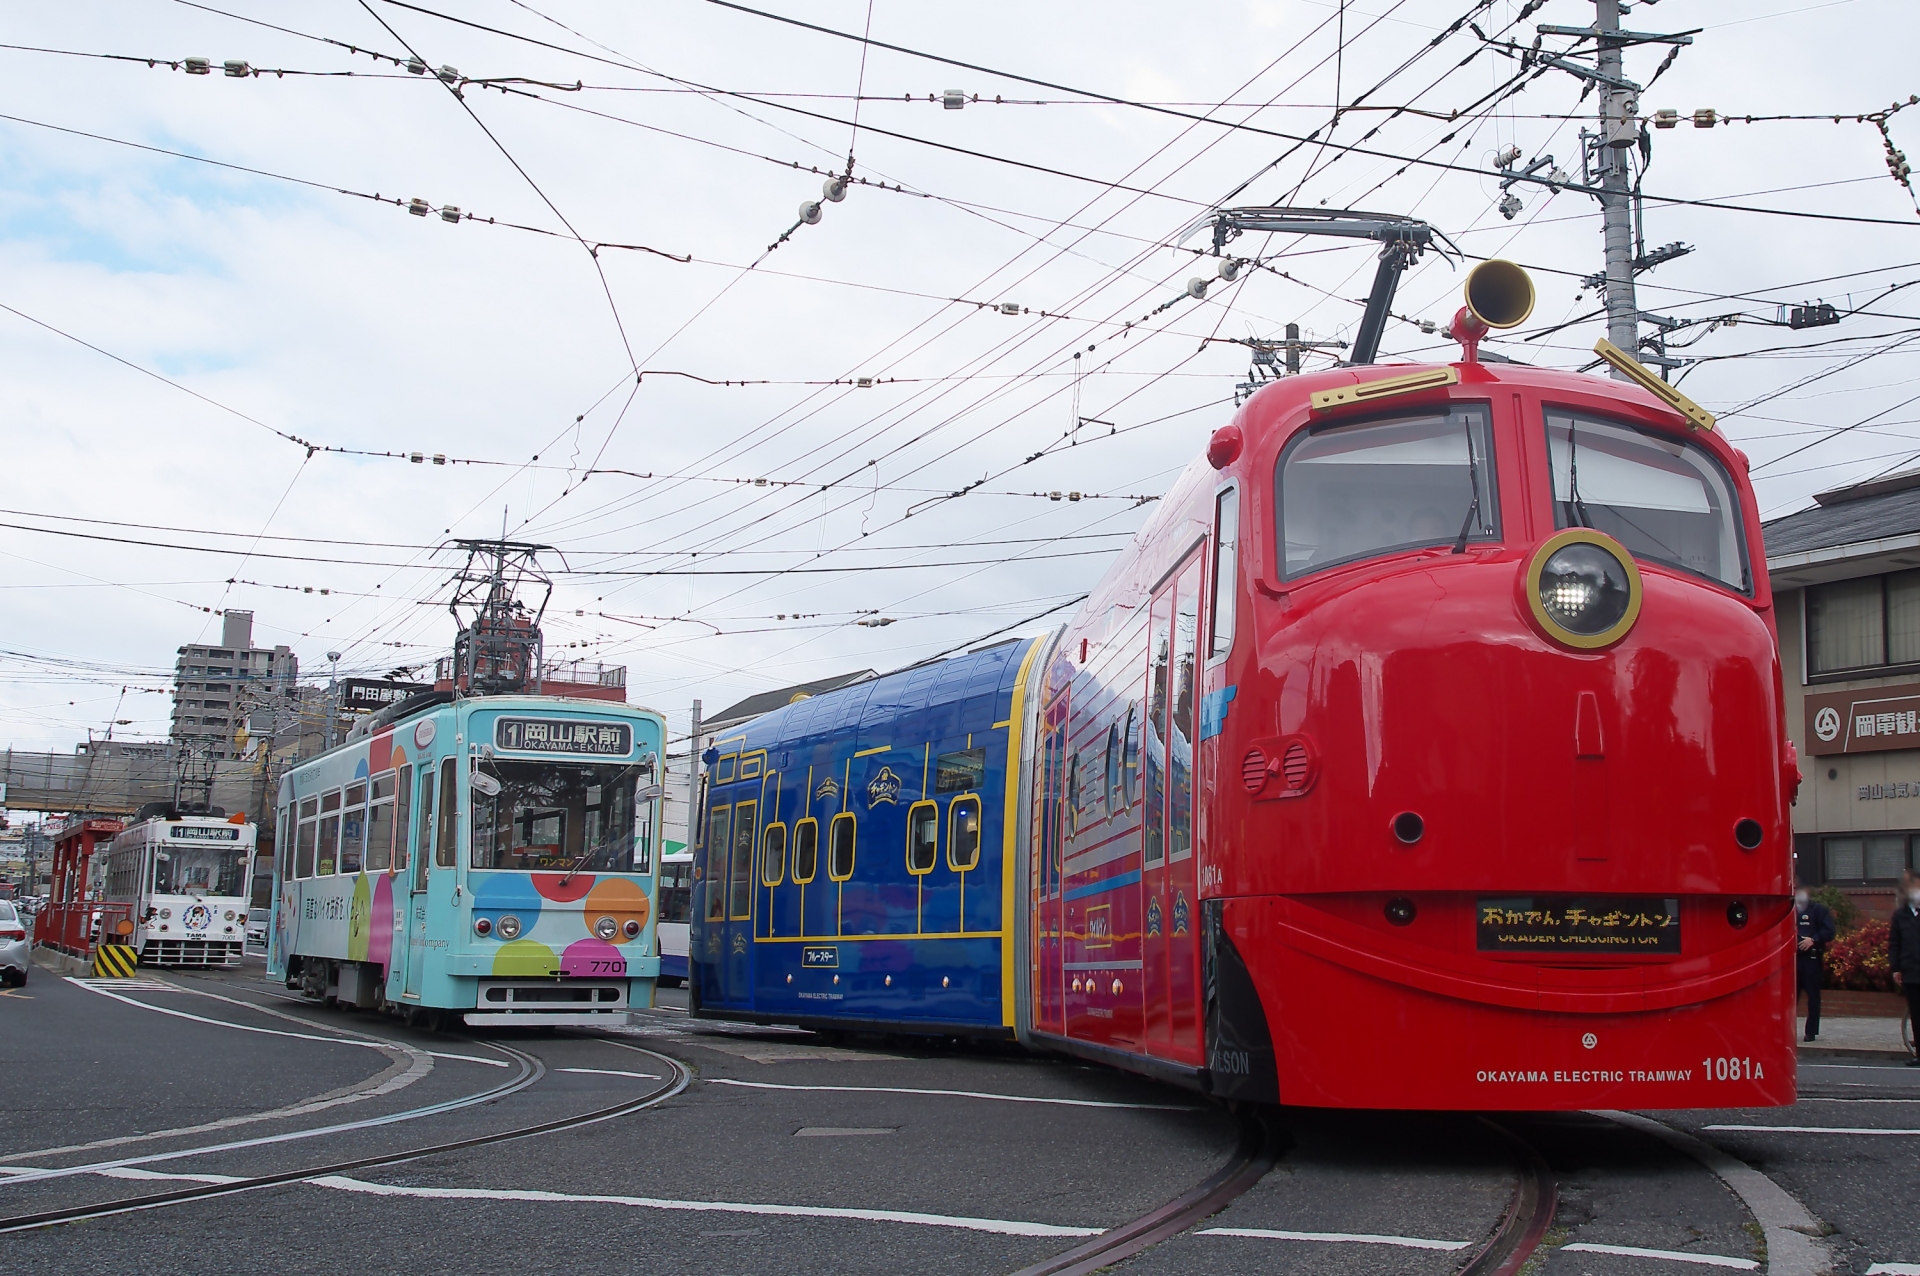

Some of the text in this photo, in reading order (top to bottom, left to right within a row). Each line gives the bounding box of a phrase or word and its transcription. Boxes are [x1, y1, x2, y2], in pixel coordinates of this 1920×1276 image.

[1855, 710, 1920, 738] 岡電観
[524, 722, 622, 746] 岡山駅前
[523, 740, 620, 754] OKAYAMA-EKIMAE
[539, 857, 575, 867] ワンマン
[591, 961, 628, 973] 7701
[1476, 1056, 1764, 1083] OKAYAMA ELECTRIC TRAMWAY 1081A
